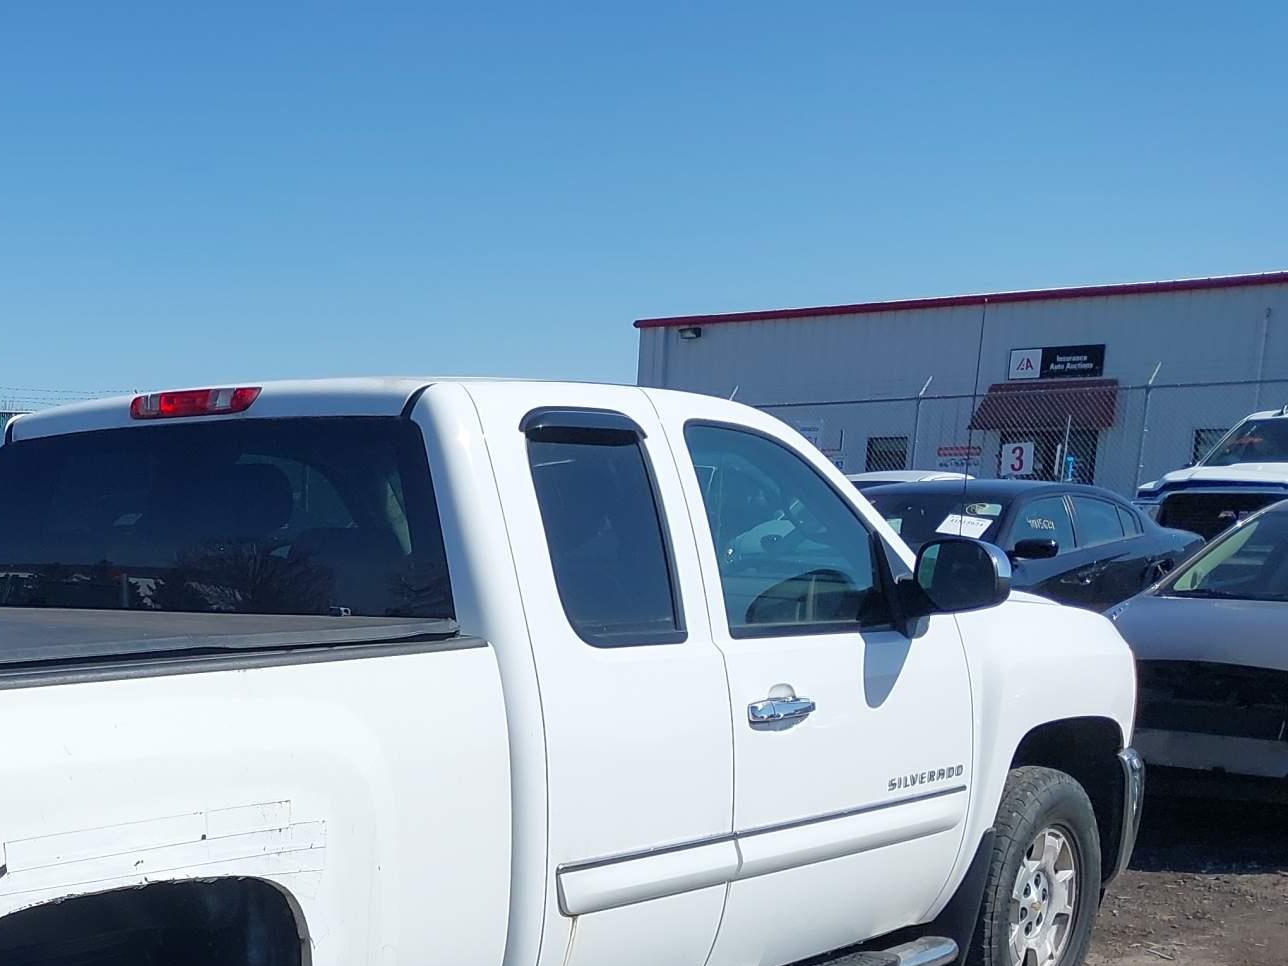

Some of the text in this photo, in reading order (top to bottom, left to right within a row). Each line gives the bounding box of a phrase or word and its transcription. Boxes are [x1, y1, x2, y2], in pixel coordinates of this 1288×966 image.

[1049, 361, 1094, 371] Auto Auctions
[1056, 354, 1088, 362] Insurance
[1010, 446, 1024, 472] 3
[887, 764, 964, 792] SILVERADO
